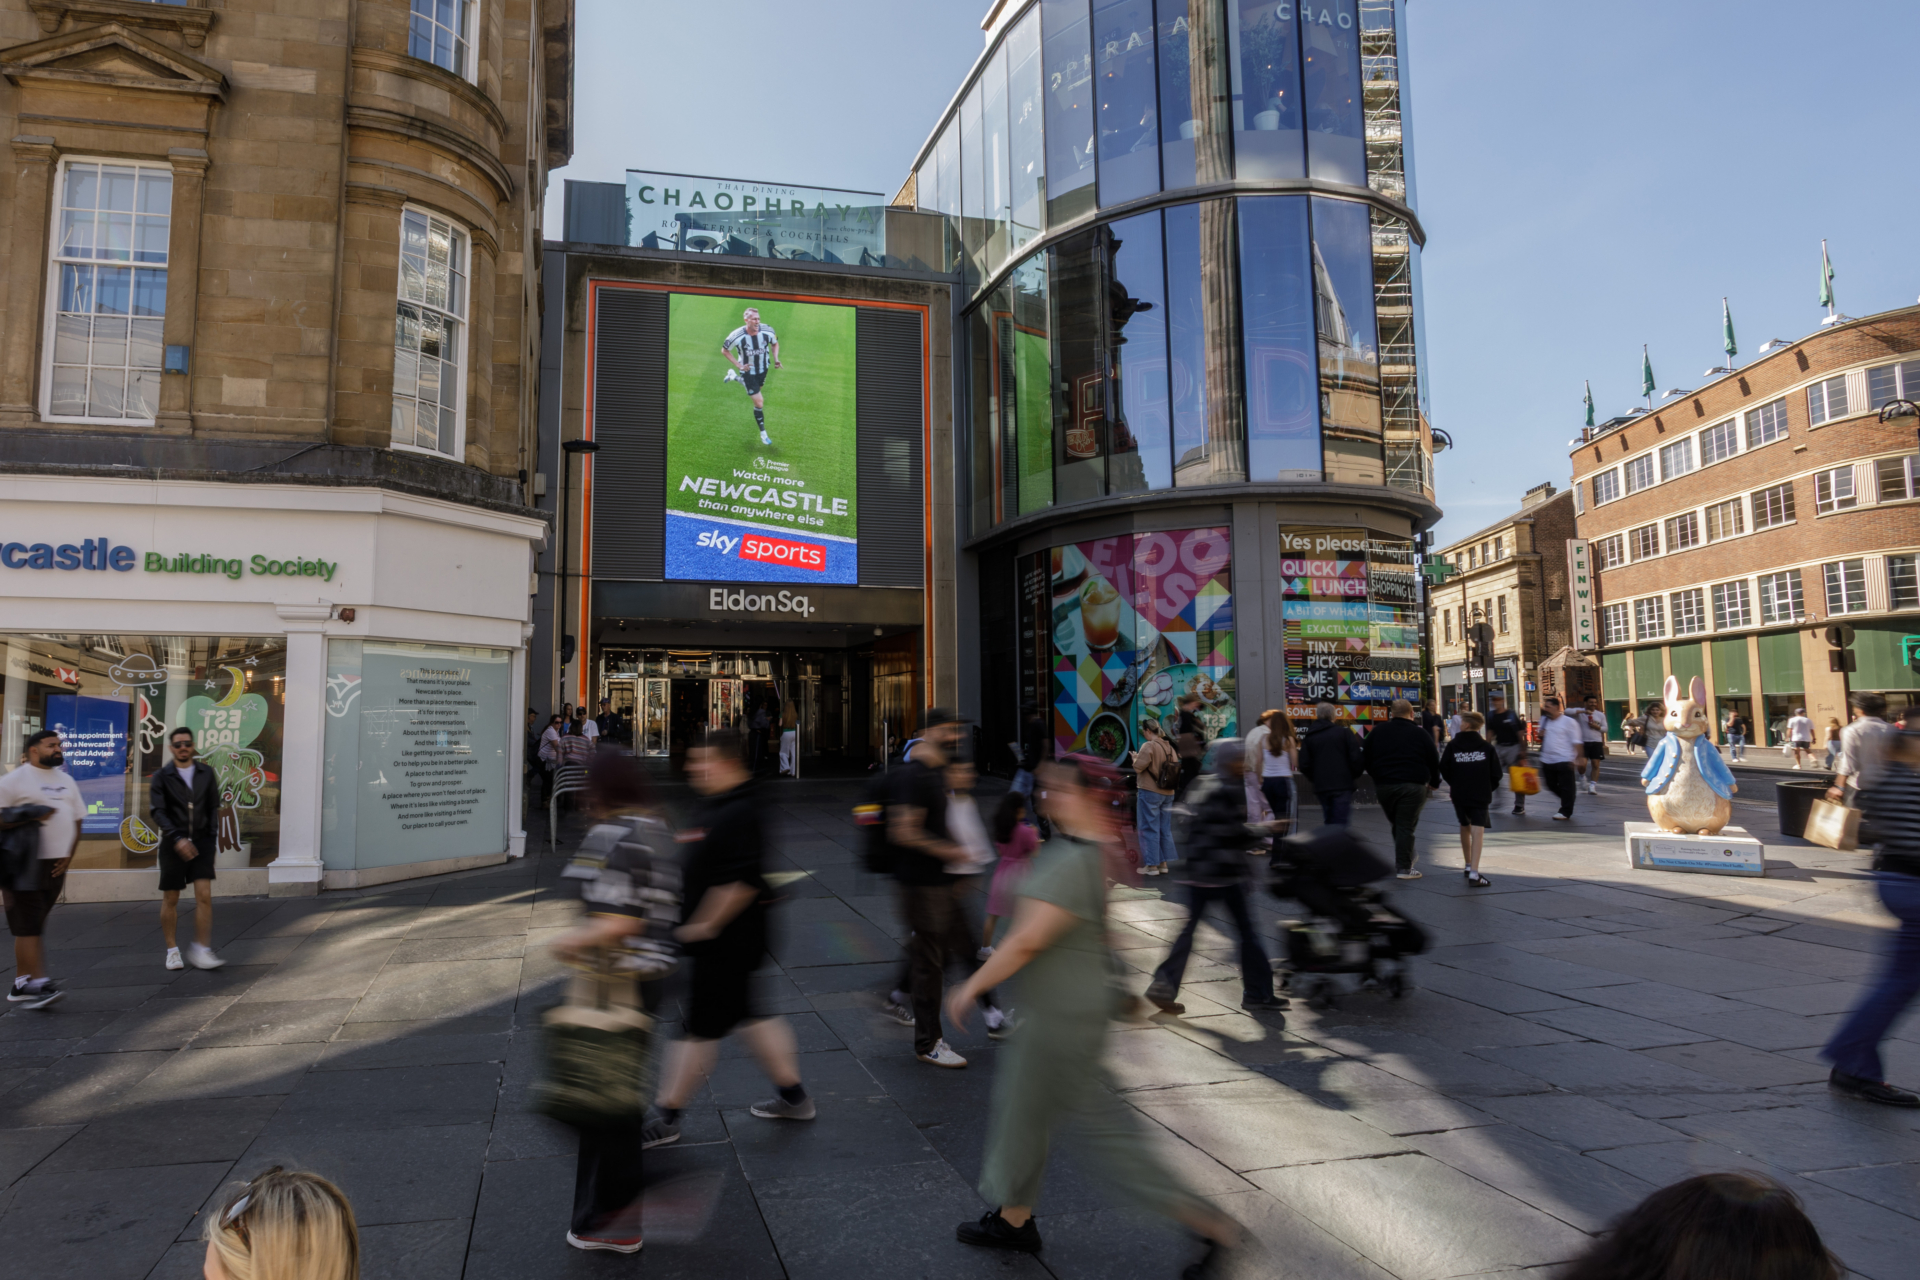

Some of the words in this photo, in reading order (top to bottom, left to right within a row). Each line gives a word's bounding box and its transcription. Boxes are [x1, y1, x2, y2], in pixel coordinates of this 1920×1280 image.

[717, 182, 745, 192] THAI
[752, 186, 796, 196] DINING
[638, 185, 874, 224] CHAOPHRAYA
[661, 219, 696, 230] ROOF
[702, 223, 759, 236] TERRACE
[780, 230, 849, 243] COCKTAILS
[766, 459, 790, 468] Premier
[766, 464, 789, 472] League
[733, 468, 770, 482] Watch
[773, 476, 805, 487] more
[698, 498, 728, 511] than
[731, 503, 795, 522] anywhere
[798, 514, 824, 526] else
[696, 530, 739, 554] sky
[745, 540, 820, 564] sports
[1281, 534, 1312, 550] Yes
[1316, 535, 1370, 554] please
[0, 538, 135, 572] castle
[144, 552, 242, 580] Building
[250, 554, 337, 582] Society
[1282, 560, 1336, 576] QUICK
[1312, 579, 1367, 595] LUNCH
[1372, 580, 1407, 598] SHOPPING
[1576, 546, 1590, 642] FENWICK
[1286, 606, 1294, 616] A
[1296, 606, 1310, 616] BIT
[1313, 607, 1327, 616] OF
[1329, 606, 1358, 616] WHAT
[1307, 624, 1350, 634] EXACTLY
[1306, 641, 1338, 654] TINY
[1307, 656, 1344, 668] PICK-
[1307, 671, 1332, 684] ME-
[1308, 686, 1334, 698] UPS
[1402, 690, 1418, 699] SWEET
[1373, 709, 1387, 718] SPICY
[80, 732, 123, 740] appointment
